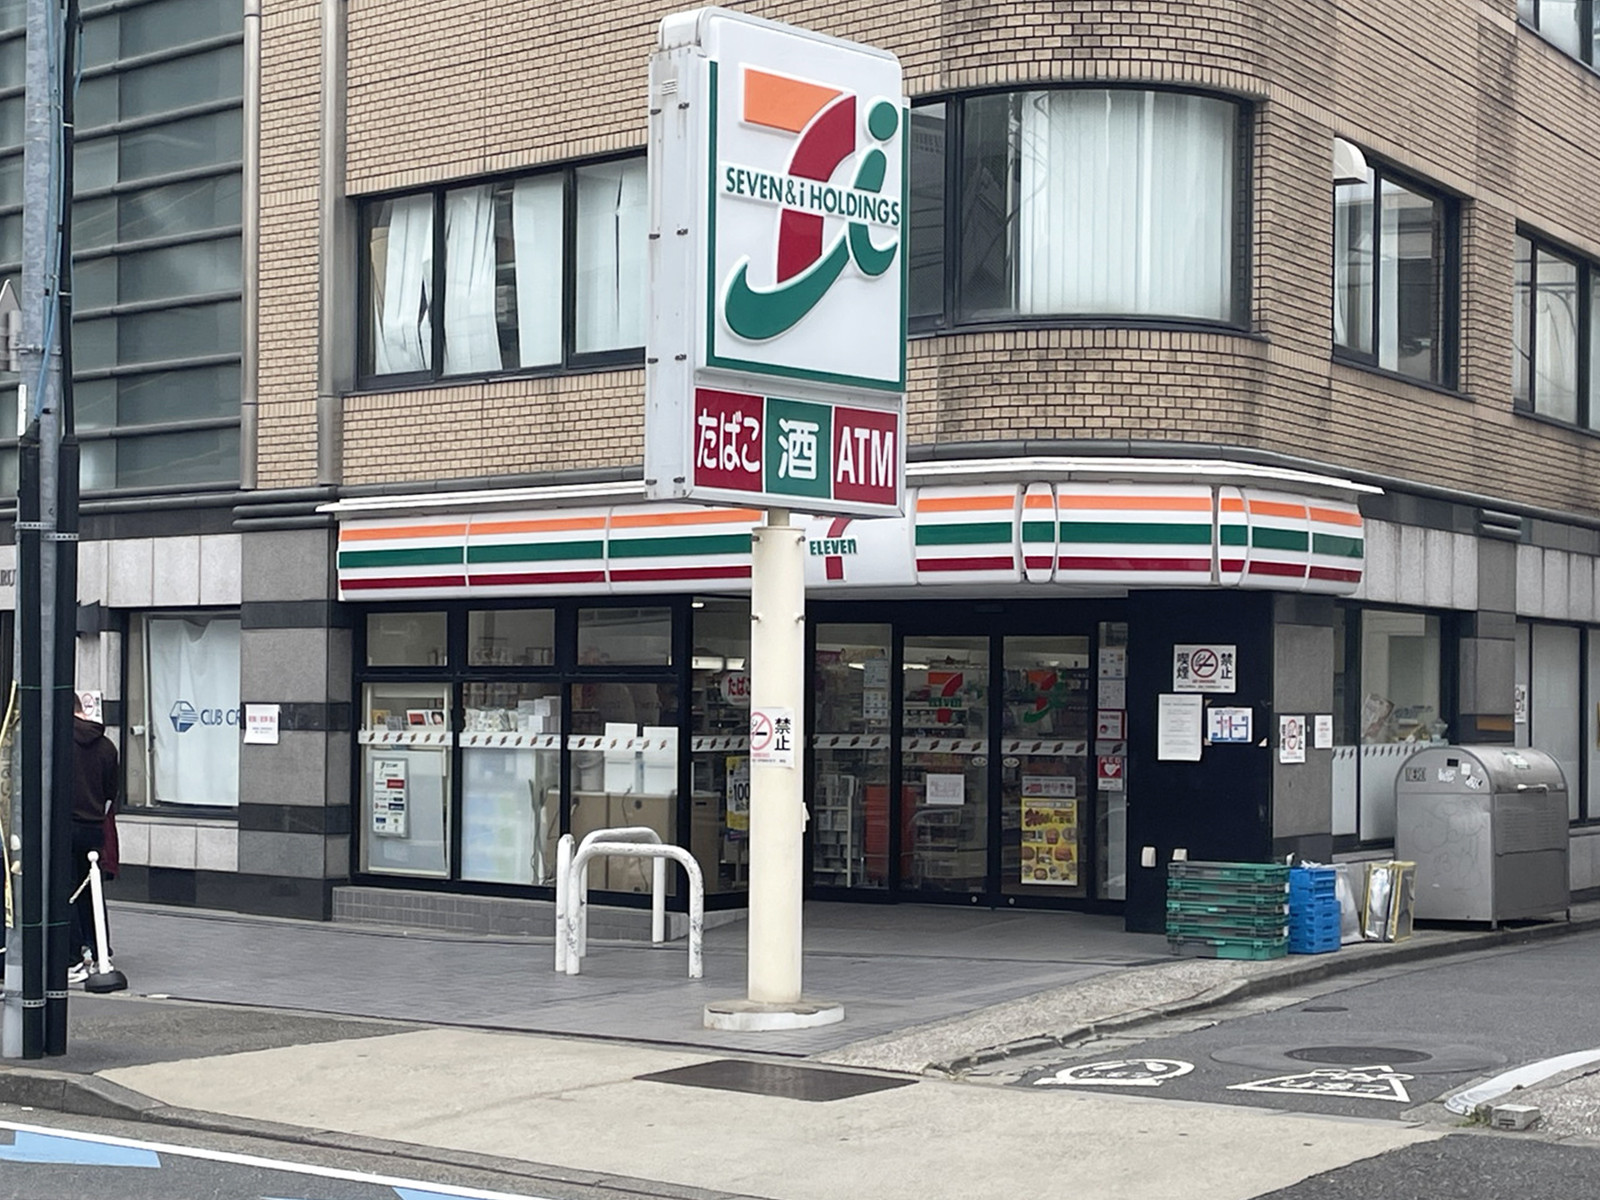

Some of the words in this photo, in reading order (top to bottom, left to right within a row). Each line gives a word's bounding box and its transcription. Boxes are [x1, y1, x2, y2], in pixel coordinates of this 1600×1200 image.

[809, 188, 900, 227] HOLDINGS
[696, 408, 762, 473] たばこ
[777, 418, 819, 480] 酒
[836, 425, 894, 489] ATM
[774, 717, 791, 751] 禁止
